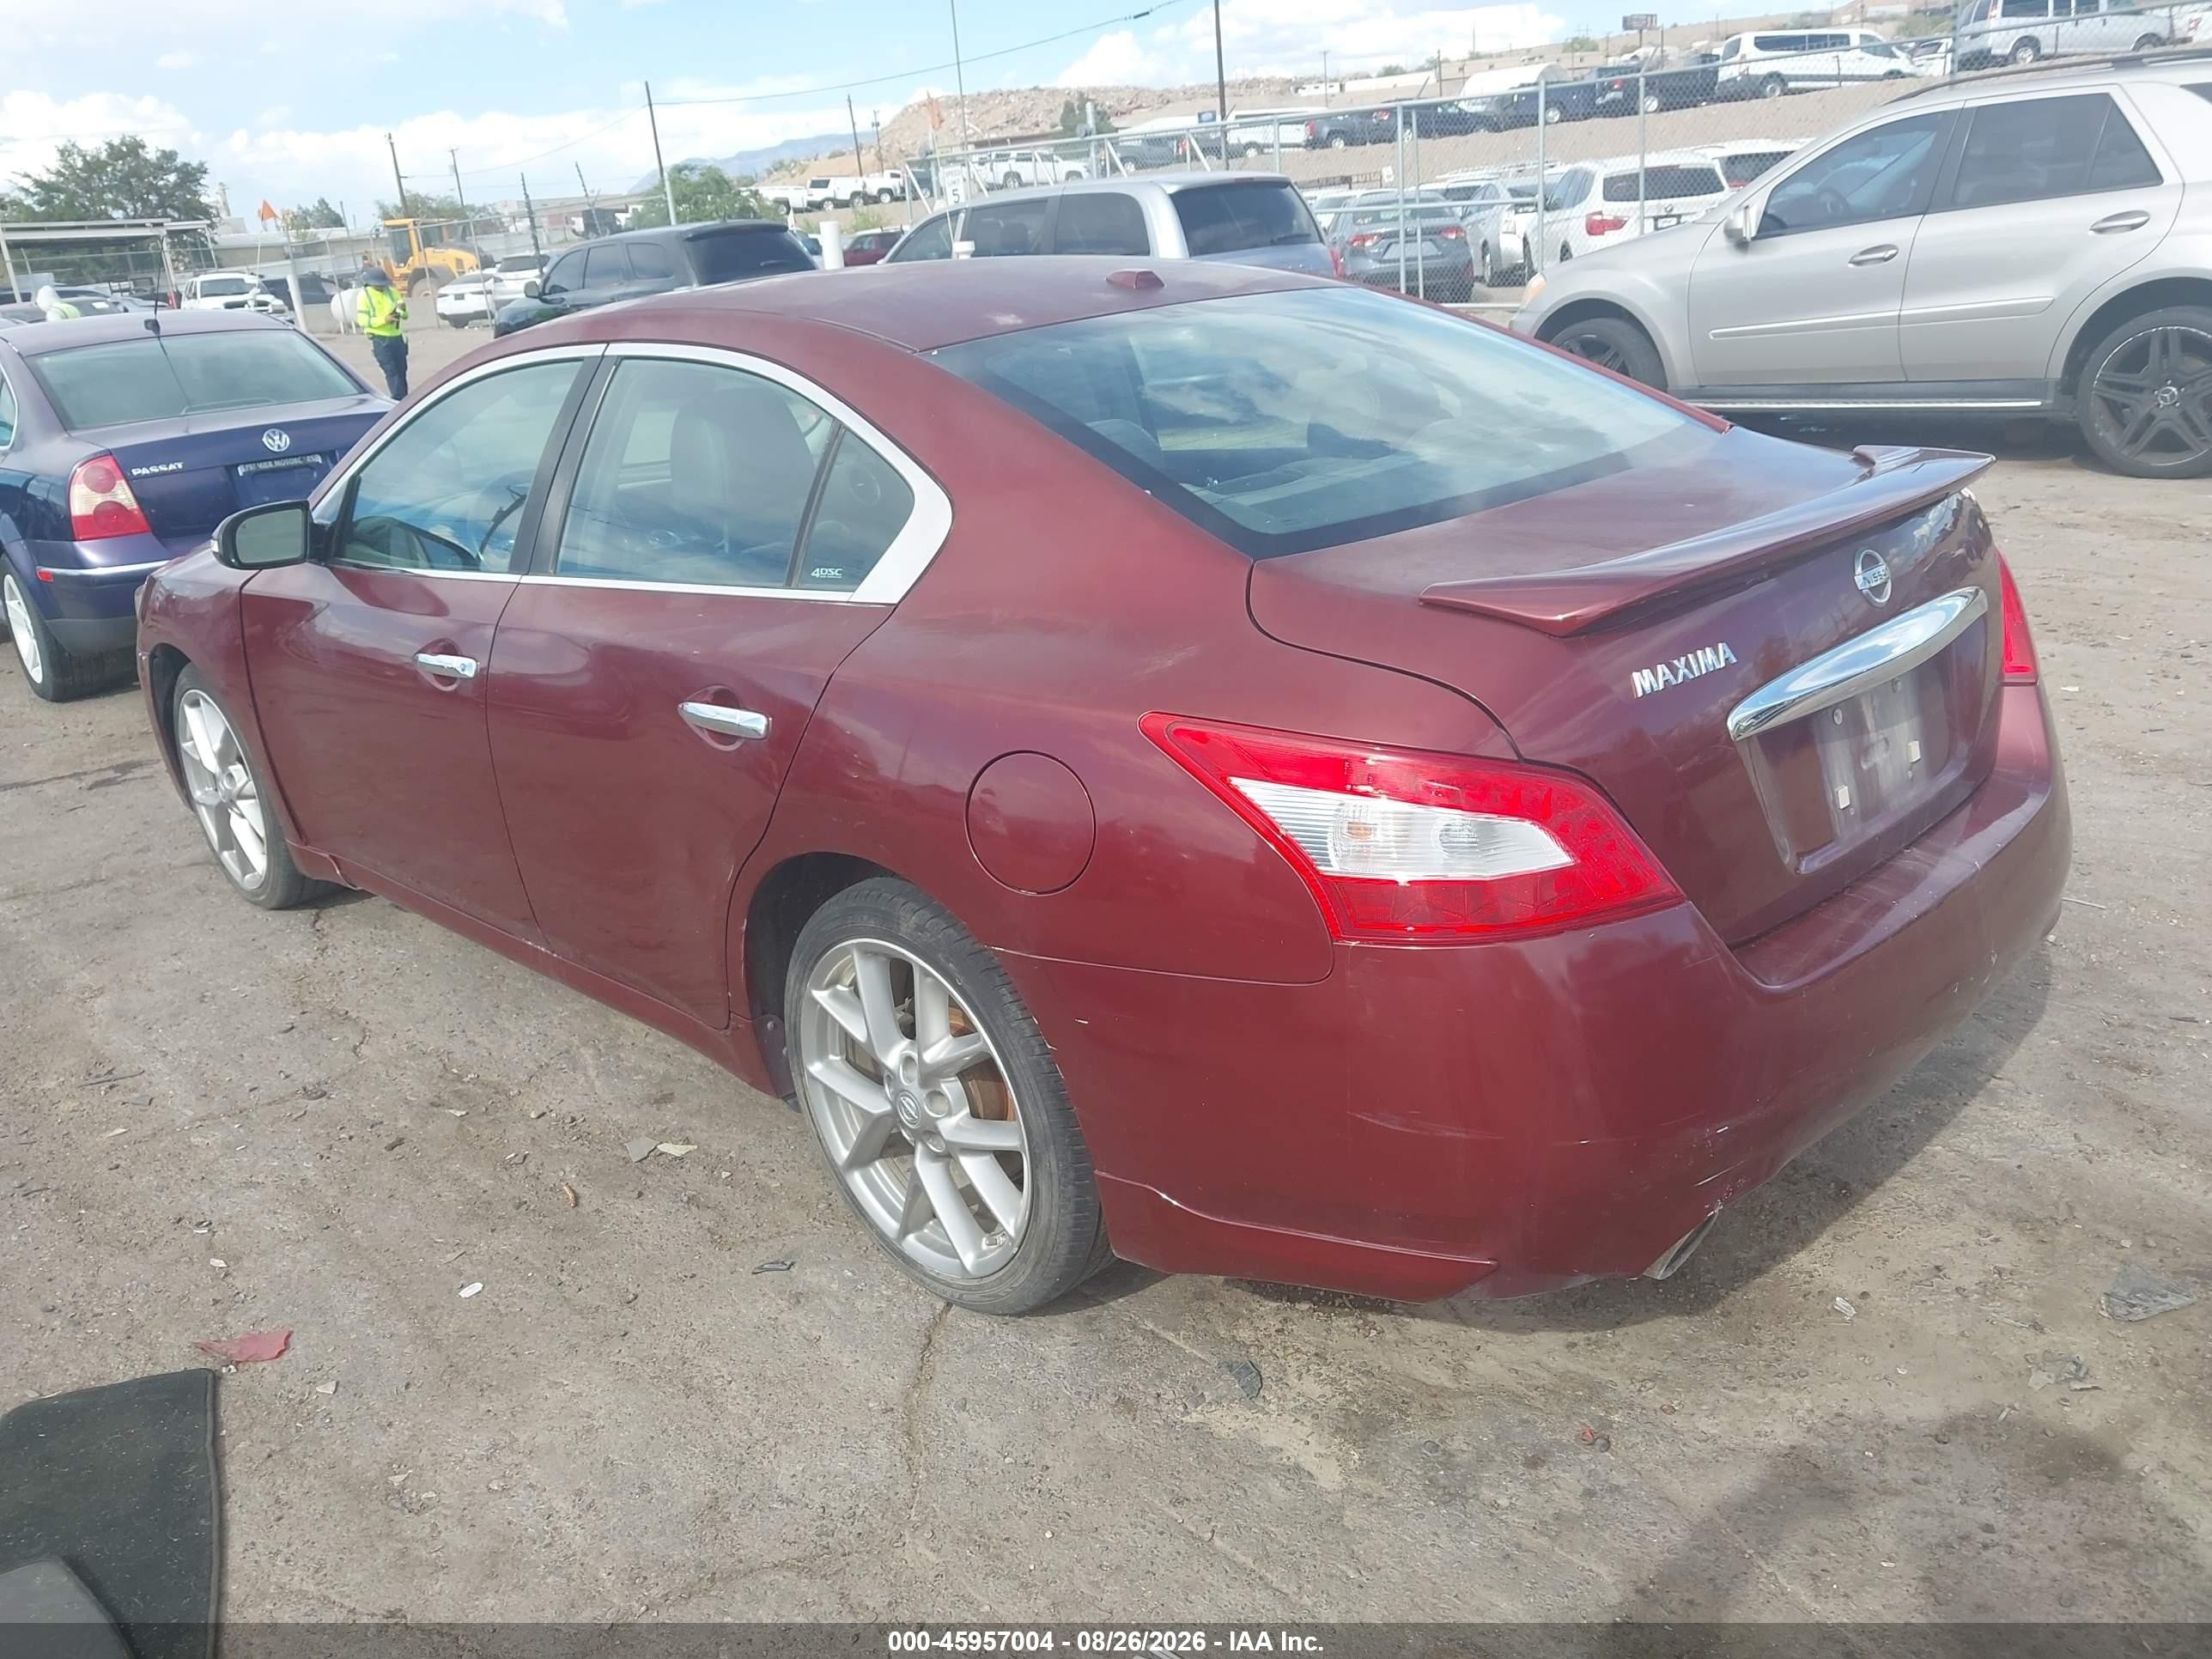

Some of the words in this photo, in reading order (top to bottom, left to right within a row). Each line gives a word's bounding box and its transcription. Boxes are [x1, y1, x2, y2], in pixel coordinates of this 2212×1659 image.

[952, 188, 960, 204] 5
[131, 461, 184, 476] PASSAT
[811, 568, 843, 577] 4DSC
[1631, 642, 1737, 698] MAXIMA
